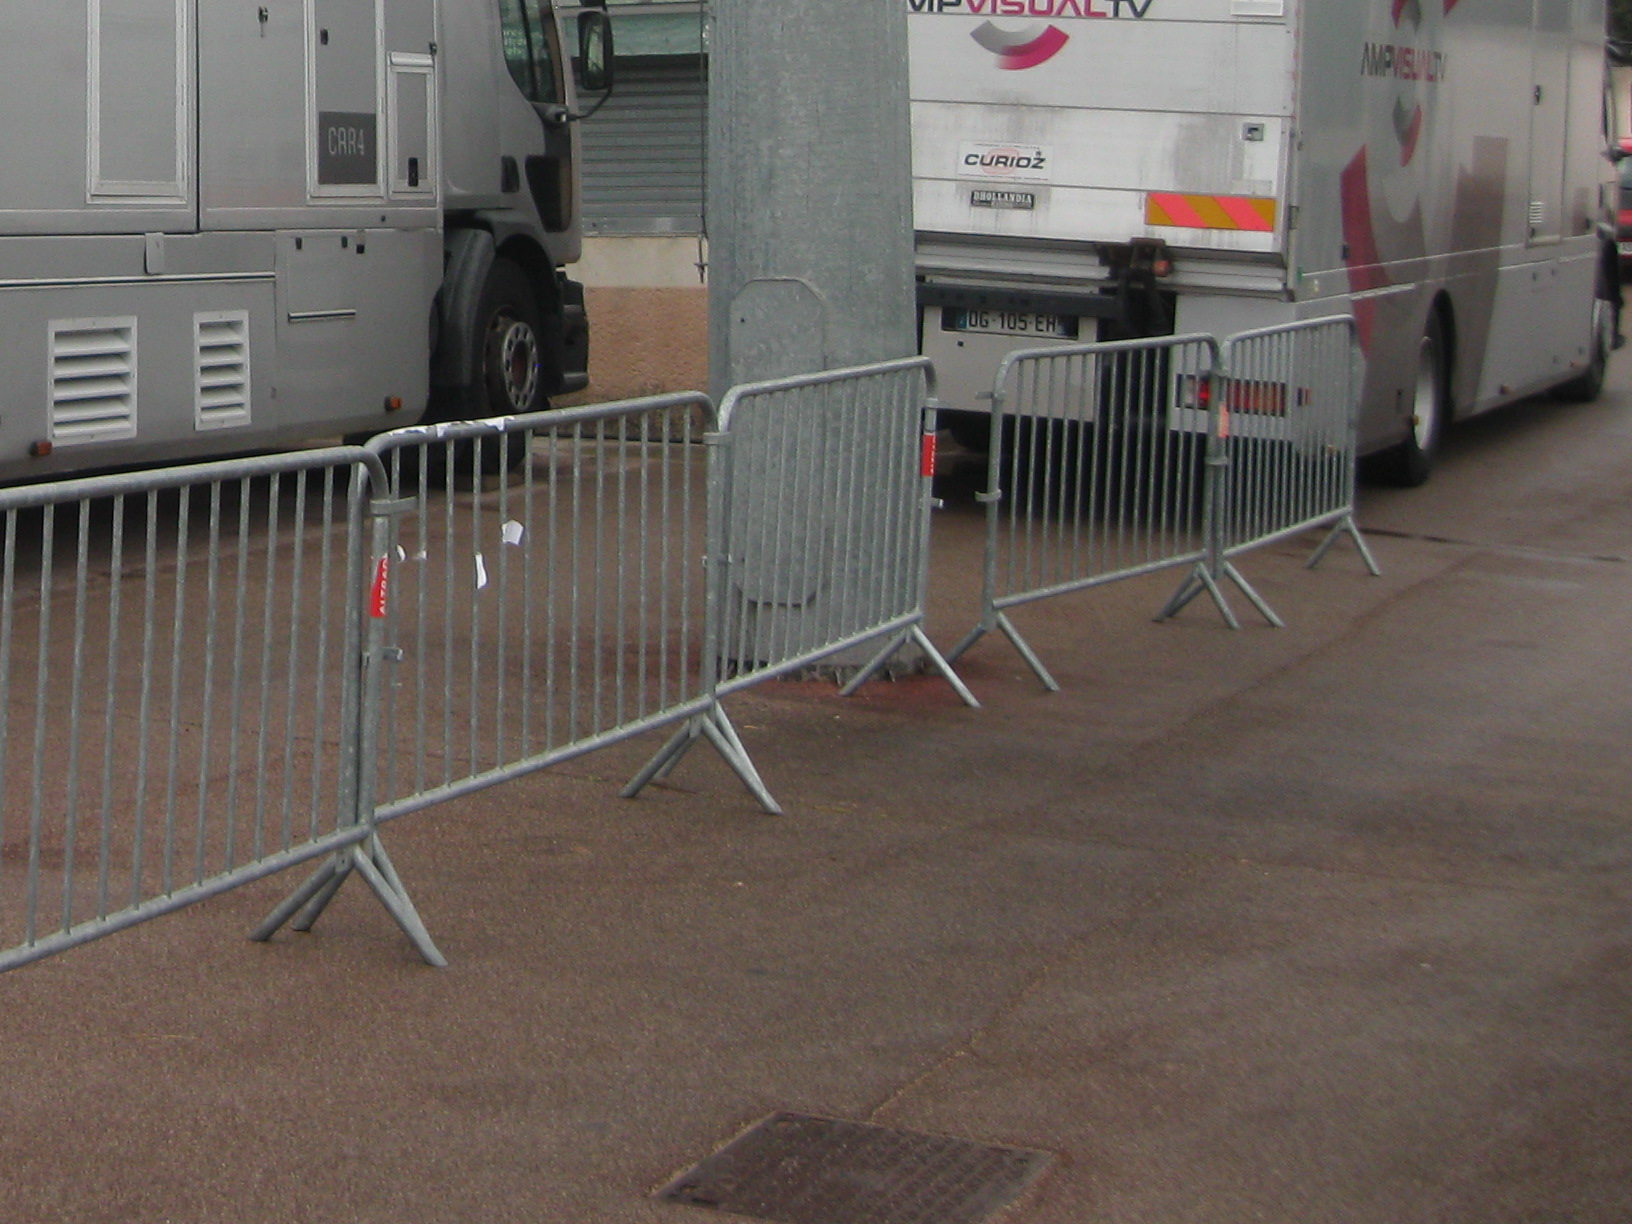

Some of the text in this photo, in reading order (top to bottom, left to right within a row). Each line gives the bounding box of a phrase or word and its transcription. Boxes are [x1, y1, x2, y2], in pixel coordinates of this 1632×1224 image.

[328, 126, 365, 156] CAR4
[964, 153, 1046, 170] CURIOZ
[972, 189, 1033, 204] DHOLLANDIA
